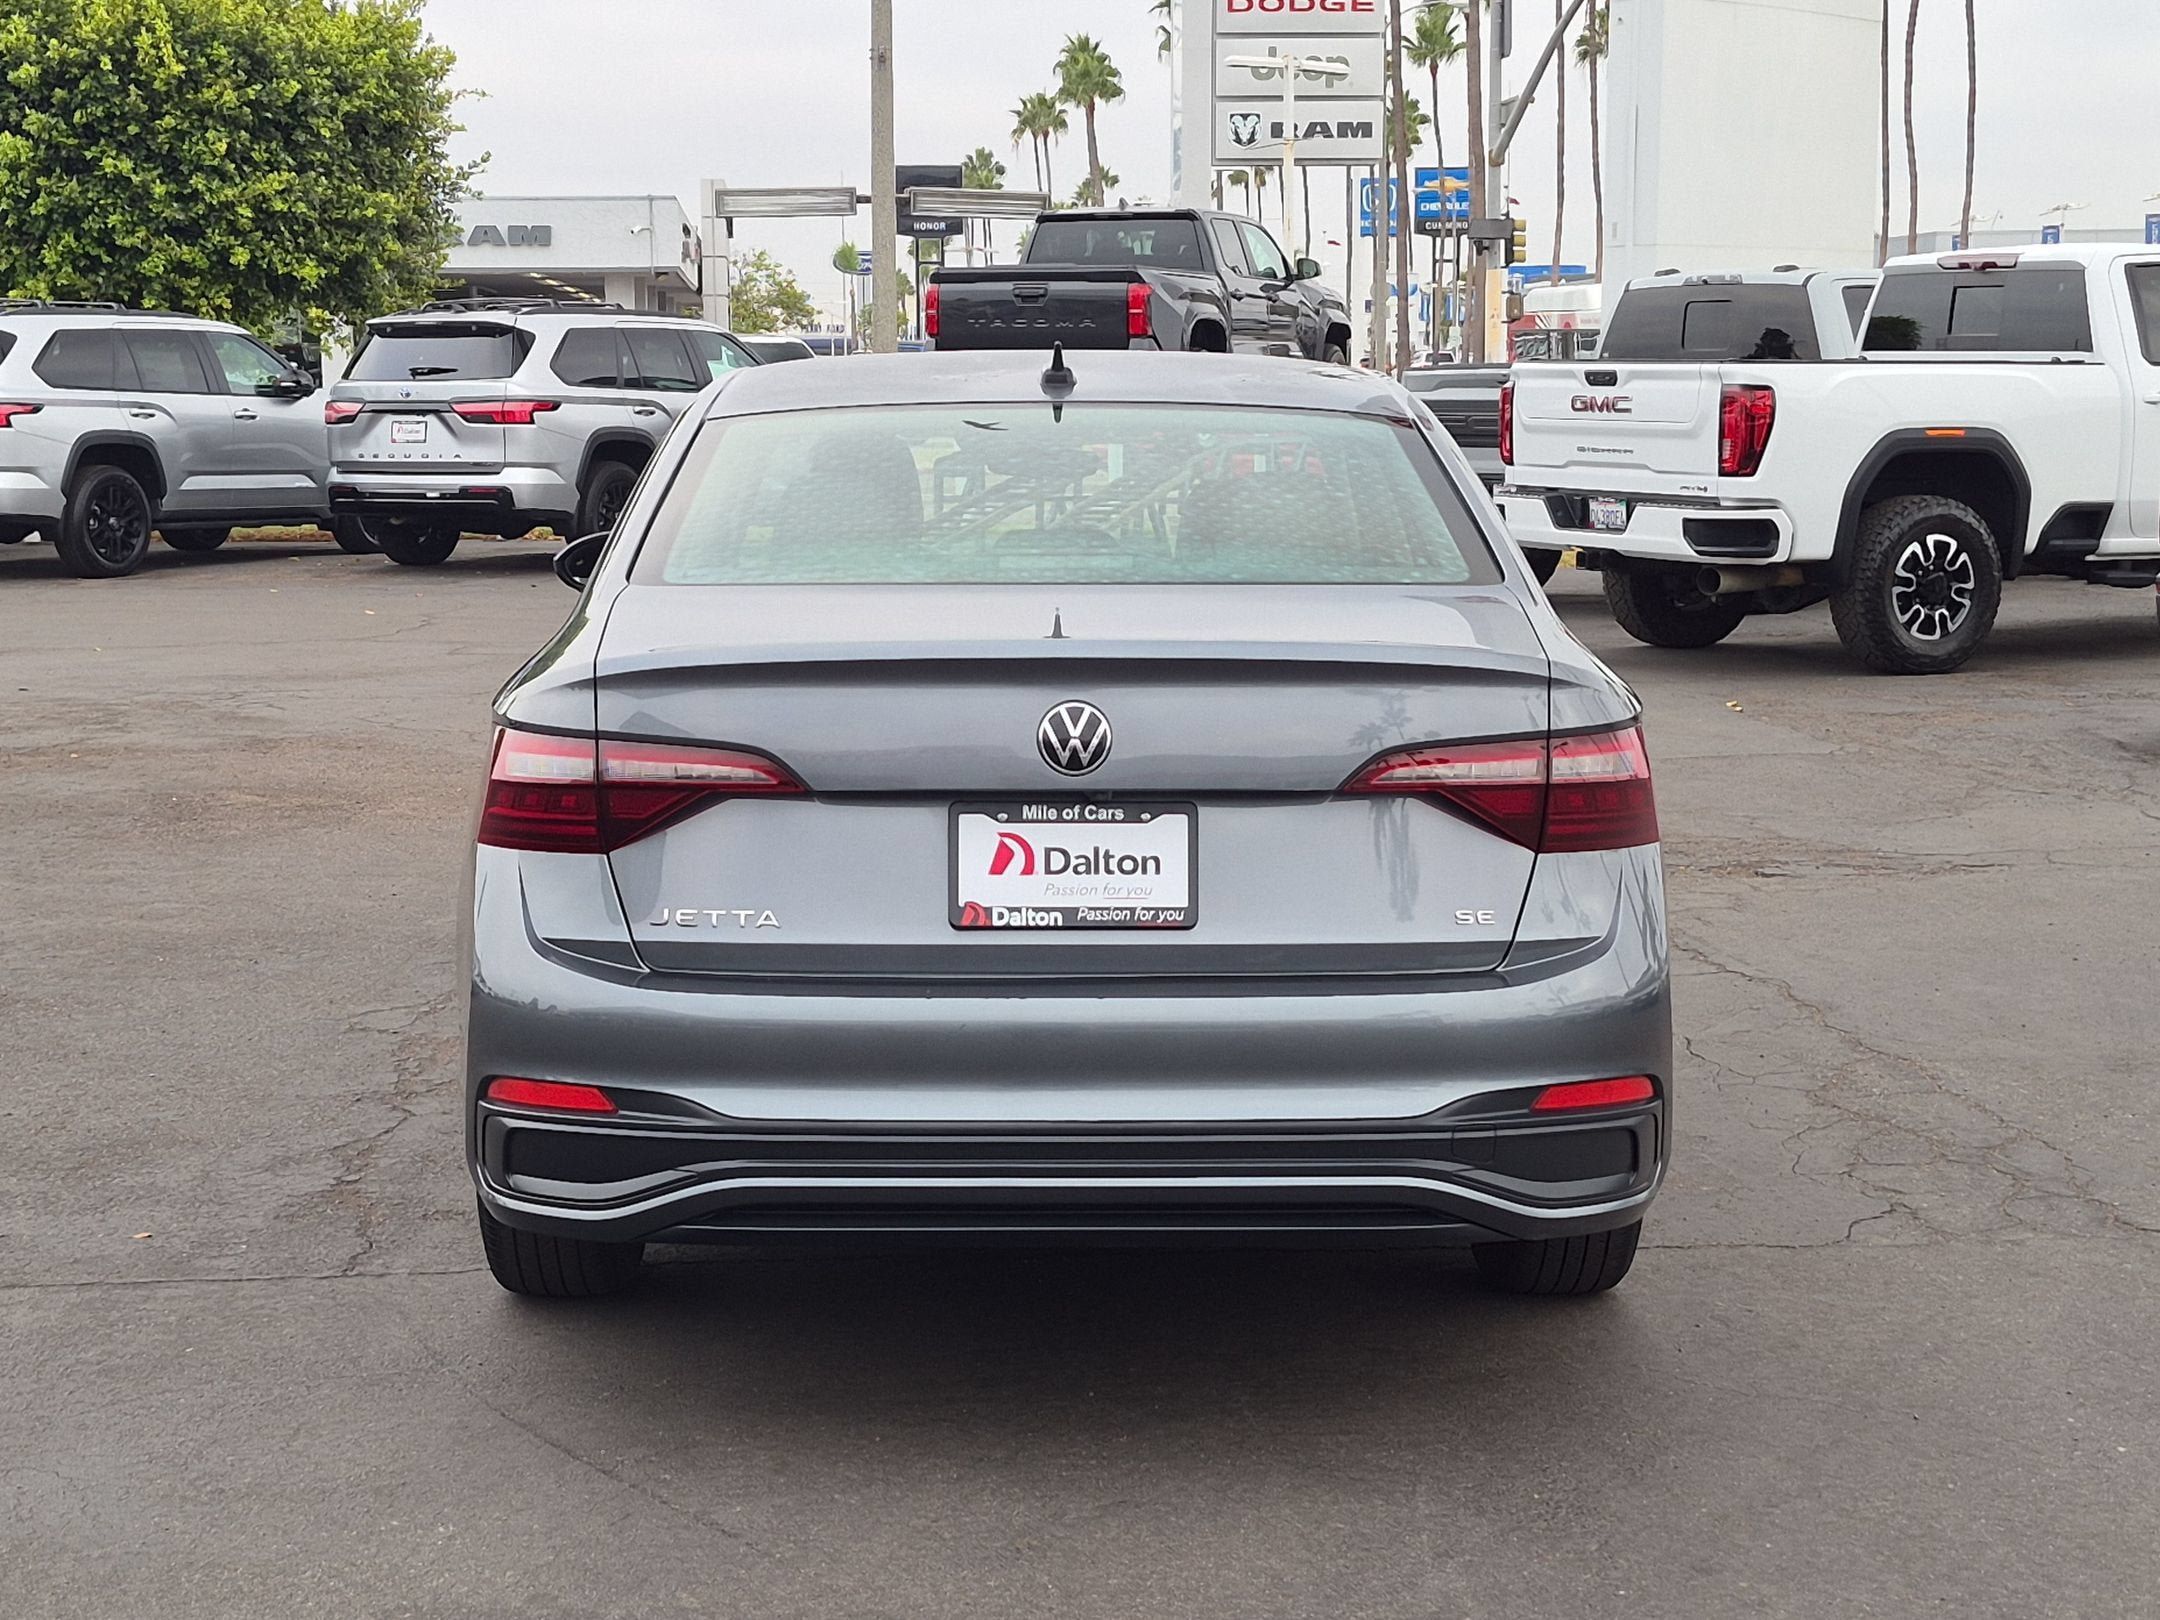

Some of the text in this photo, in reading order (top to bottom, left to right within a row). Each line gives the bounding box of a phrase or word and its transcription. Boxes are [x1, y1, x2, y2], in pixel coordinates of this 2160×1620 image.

[1227, 0, 1375, 13] DODGE
[913, 221, 947, 231] HONOR
[967, 319, 1097, 328] TACOMA
[1571, 395, 1633, 413] GMC
[1022, 804, 1125, 821] Mile of Cars
[1043, 846, 1161, 876] Dalton
[1043, 882, 1153, 899] Passion for you
[649, 907, 782, 929] JETTA
[991, 906, 1185, 927] Dalton Passion for you
[1455, 910, 1496, 925] SE
